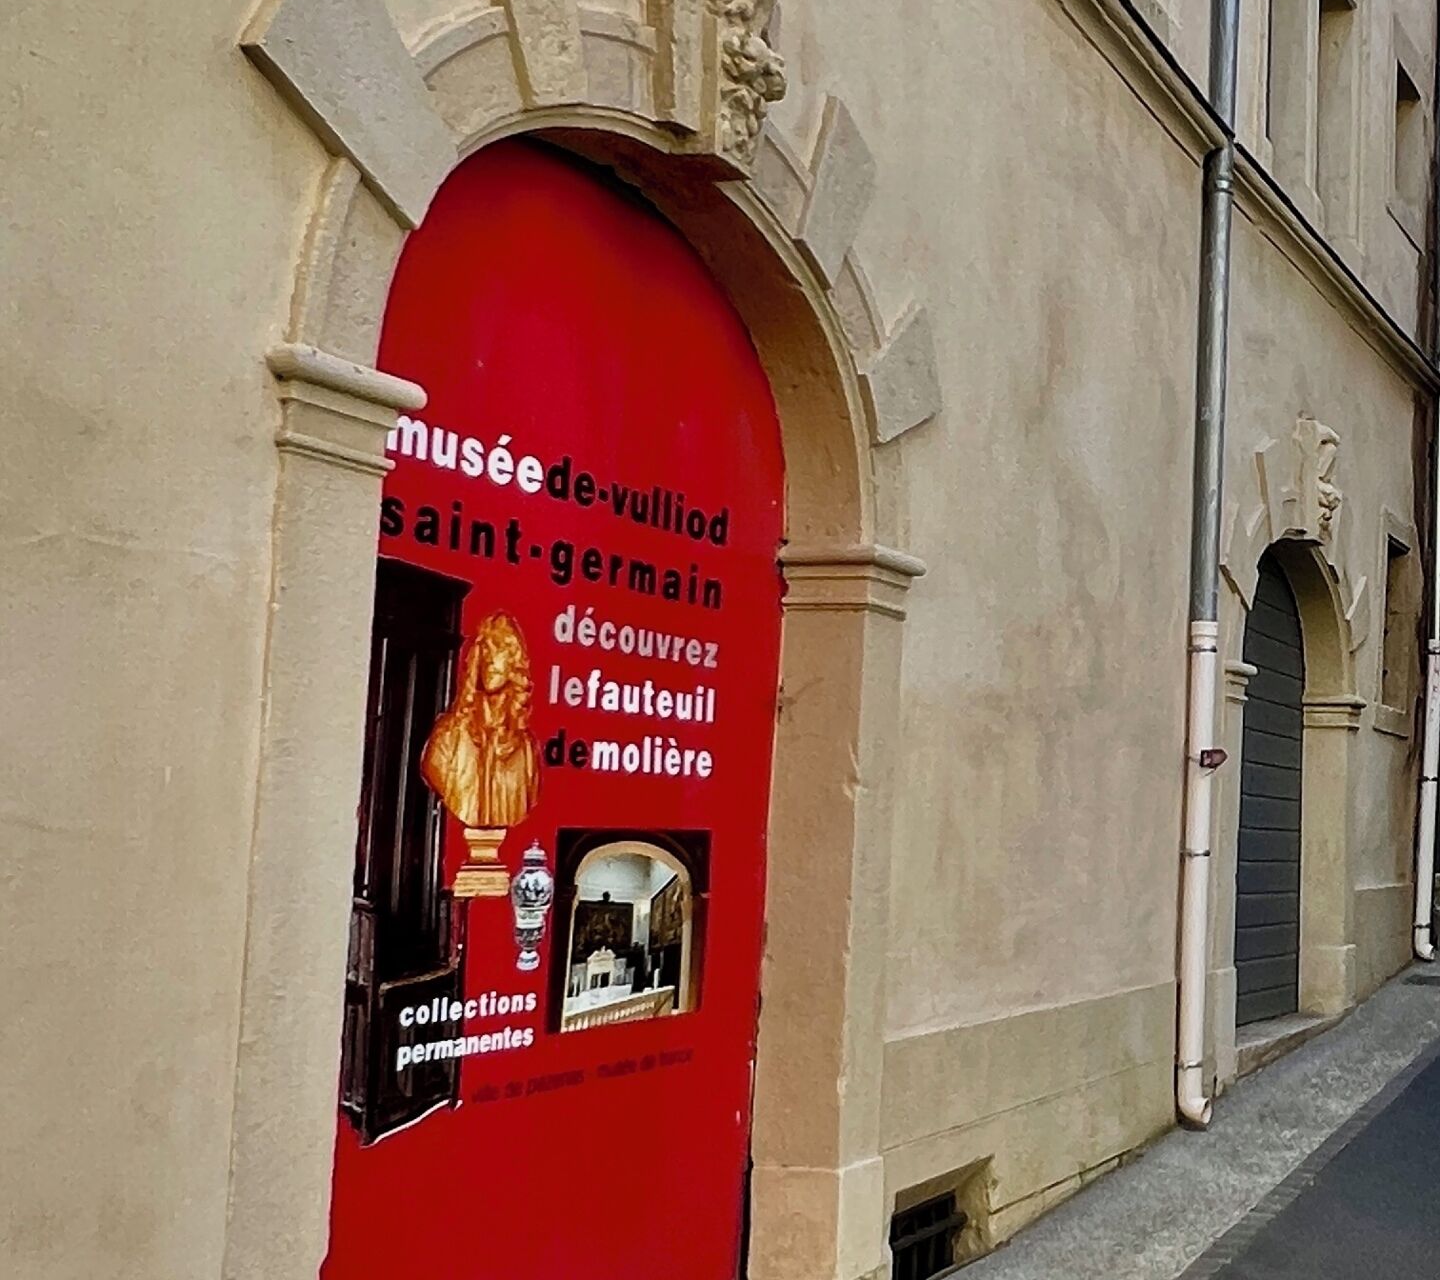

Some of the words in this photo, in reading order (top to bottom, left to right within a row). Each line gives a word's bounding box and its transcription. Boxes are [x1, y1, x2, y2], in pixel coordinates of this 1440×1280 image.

[387, 414, 544, 494] musée
[554, 604, 719, 669] découvrez
[399, 990, 537, 1027] collections
[396, 1026, 534, 1072] permanentes
